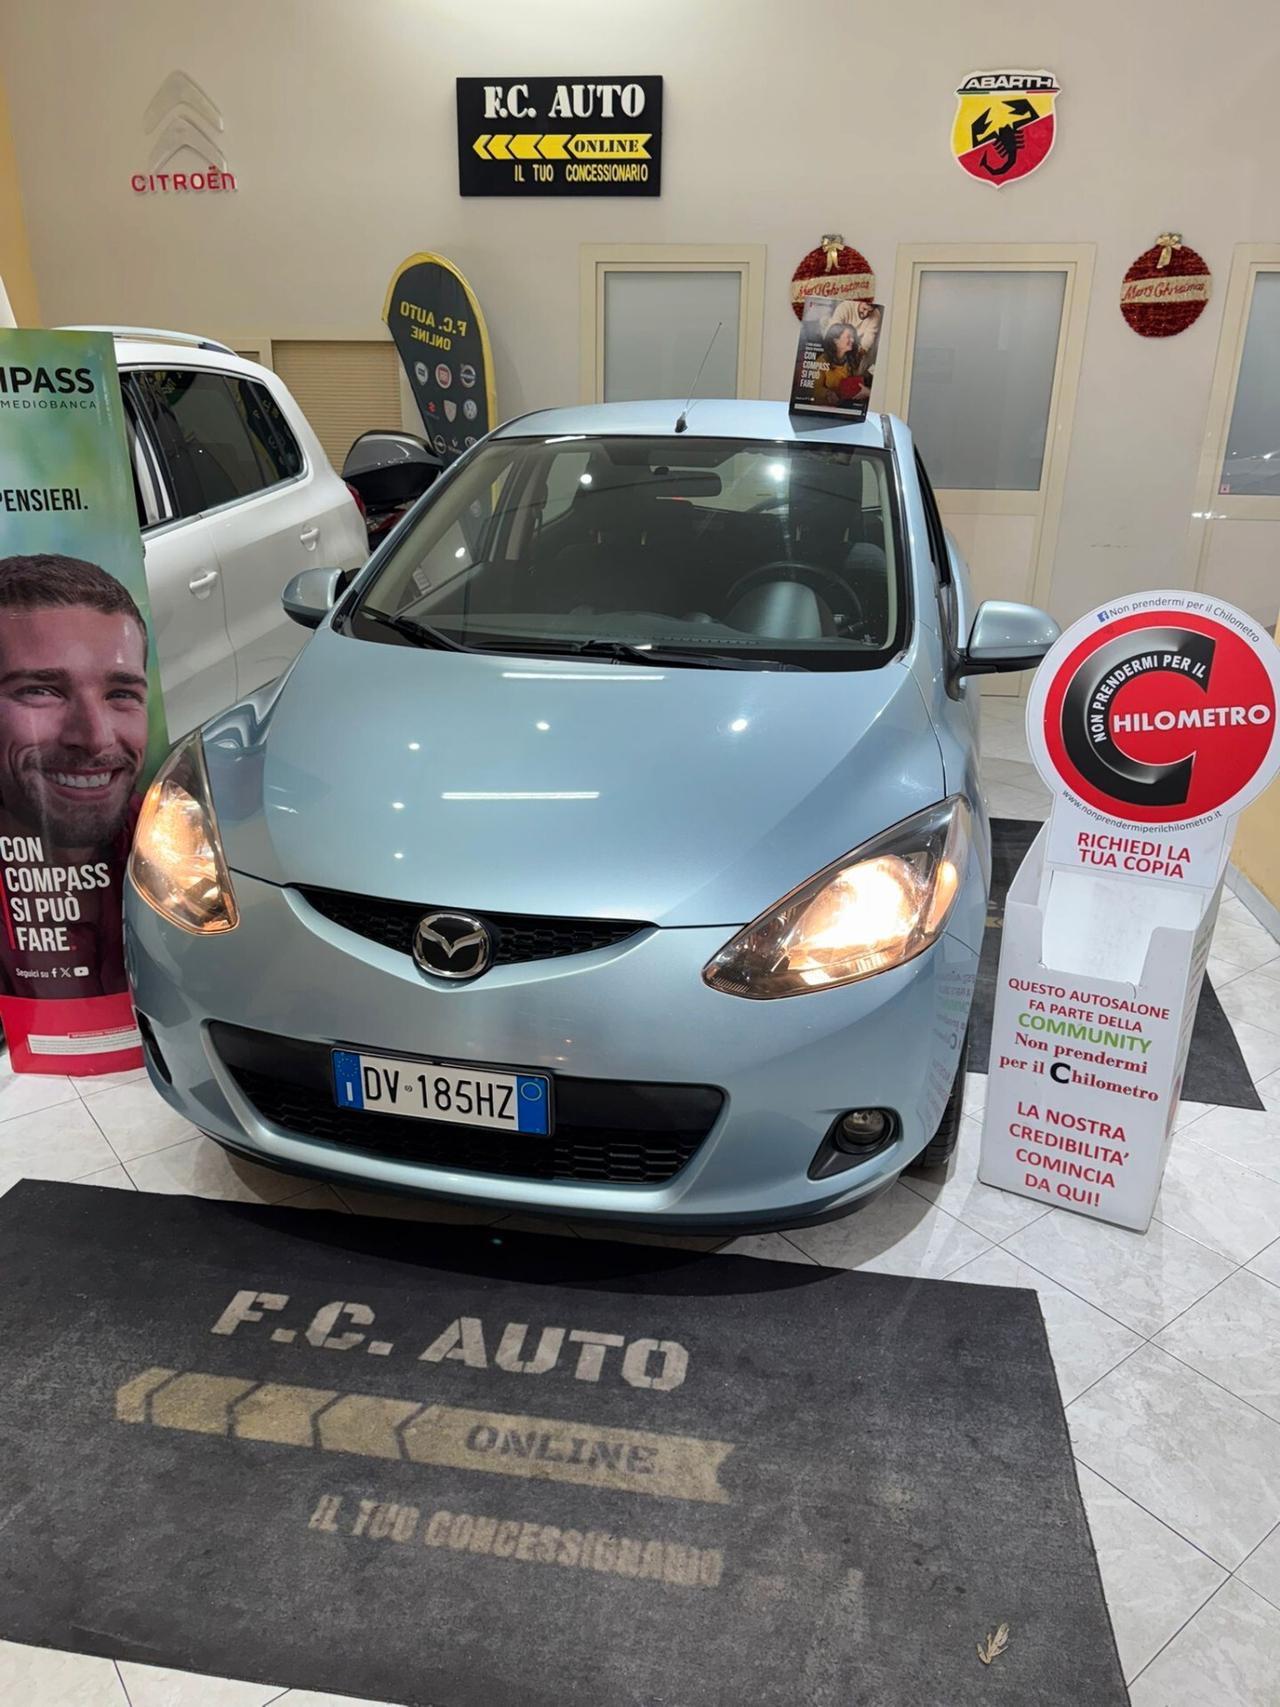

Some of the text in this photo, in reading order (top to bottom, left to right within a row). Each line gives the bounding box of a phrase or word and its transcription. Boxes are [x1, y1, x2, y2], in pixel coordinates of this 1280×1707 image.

[965, 75, 1052, 89] ABARTH
[483, 84, 646, 119] F.C. AUTO
[574, 139, 640, 153] ONLINE
[514, 163, 648, 182] IL TUO CONCESSIONARIO
[1, 400, 97, 409] MEDIOBANCA
[0, 487, 89, 512] ENSIERI.
[1109, 597, 1261, 643] Non prendermi per il Chilometro
[1090, 654, 1207, 743] NON PRENDERMI PER IL
[1061, 789, 1223, 834] www.nonprendermiperilchilometro.it
[0, 836, 44, 862] CON
[1077, 831, 1191, 863] RICHIEDI LA
[1079, 848, 1184, 878] TUA COPIA
[5, 862, 111, 893] COMPASS
[10, 890, 81, 923] SI PUÒ
[15, 967, 40, 979] Seguici
[1008, 977, 1170, 1020] QUESTO AUTOSALONE
[1028, 999, 1143, 1033] FA PARTE DELLA
[1018, 1012, 1152, 1054] COMMUNITY
[1014, 1032, 1149, 1074] Non prendermi
[363, 1066, 400, 1104] DV
[417, 1074, 515, 1121] 185HZ
[999, 1054, 1159, 1102] per il Chilometro
[1017, 1101, 1127, 1142] LA NOSTRA
[1016, 1148, 1116, 1188] COMINCIA
[1025, 1173, 1101, 1208] DA QUI!
[210, 1289, 690, 1392] F.C. AUTO
[464, 1424, 661, 1477] ONLINE
[308, 1494, 343, 1532] IL
[352, 1499, 420, 1543] TUO
